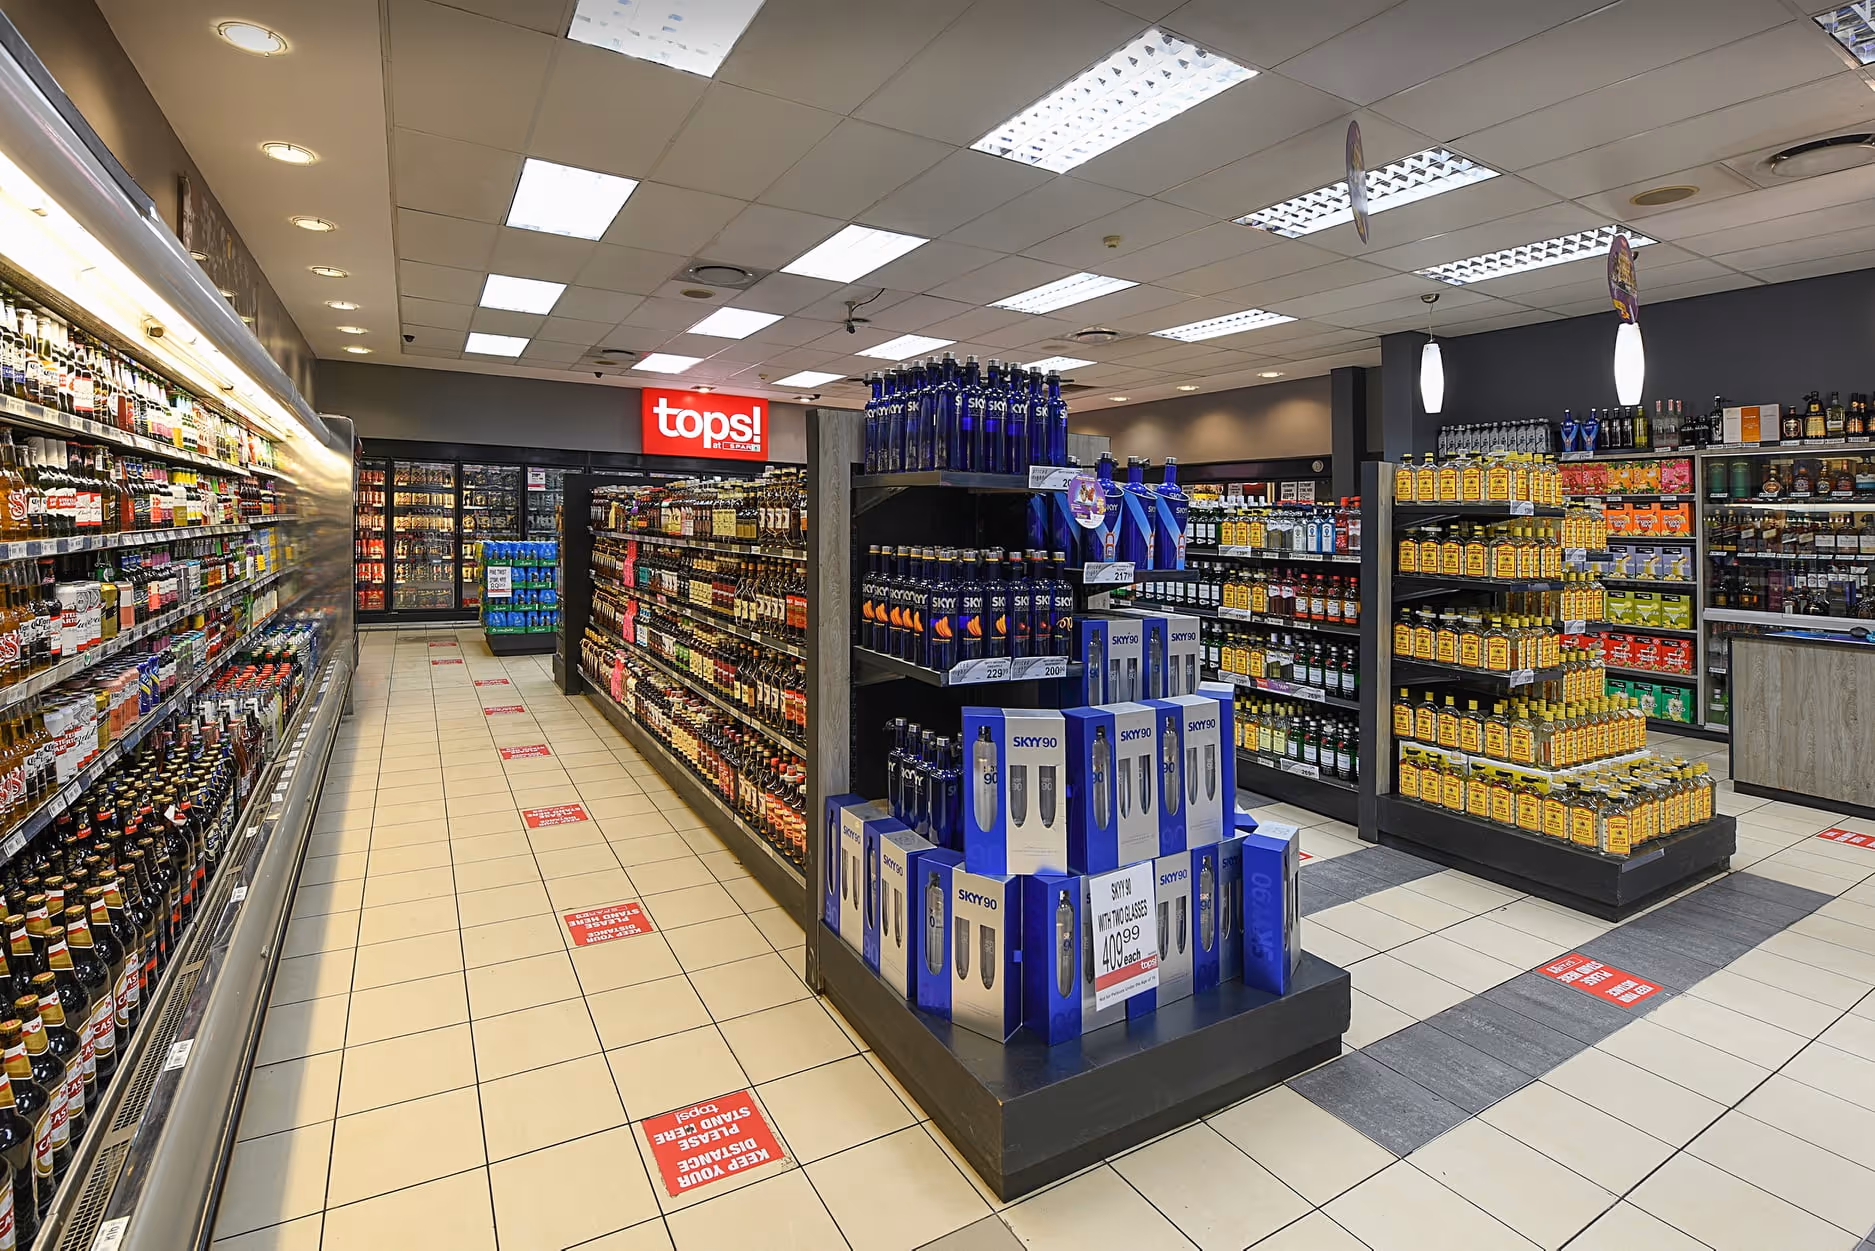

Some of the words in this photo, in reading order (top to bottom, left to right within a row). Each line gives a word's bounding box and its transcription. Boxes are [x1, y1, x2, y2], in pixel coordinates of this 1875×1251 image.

[653, 397, 760, 448] tops!
[713, 441, 722, 449] at
[1115, 572, 1127, 581] 217
[932, 597, 956, 609] SKYY
[987, 668, 1003, 679] 229
[1045, 666, 1060, 676] 200
[1188, 720, 1206, 732] SKYY
[1206, 719, 1216, 729] 90
[1013, 736, 1042, 748] SKYY
[1042, 737, 1057, 748] 90
[1120, 729, 1140, 742] SKYY
[1141, 727, 1151, 739] 90
[883, 854, 896, 872] SKYY
[896, 863, 903, 877] 90
[1160, 872, 1178, 885] SKYY
[1178, 869, 1188, 880] 90
[1111, 880, 1125, 901] SKYY
[1125, 878, 1132, 896] 90
[958, 889, 984, 906] SKYY
[984, 896, 997, 910] 90
[602, 908, 640, 919] STAND
[1098, 911, 1112, 933] WITH
[1111, 907, 1125, 928] TWO
[1125, 899, 1148, 923] GLASSES
[568, 916, 600, 927] HERE
[584, 916, 630, 929] PLEASE
[587, 923, 636, 938] DISTANCE
[616, 928, 642, 937] KEEP
[586, 934, 614, 943] YOUR
[1102, 931, 1123, 973] 409
[1124, 948, 1141, 966] each
[1140, 955, 1157, 970] tops!
[675, 1103, 719, 1124] tops!
[700, 1106, 751, 1130] STAND
[653, 1123, 697, 1145] HERE
[677, 1123, 740, 1151] PLEASE
[676, 1137, 758, 1173] DISTANCE
[727, 1148, 771, 1171] KEEP
[676, 1164, 725, 1188] YOUR
